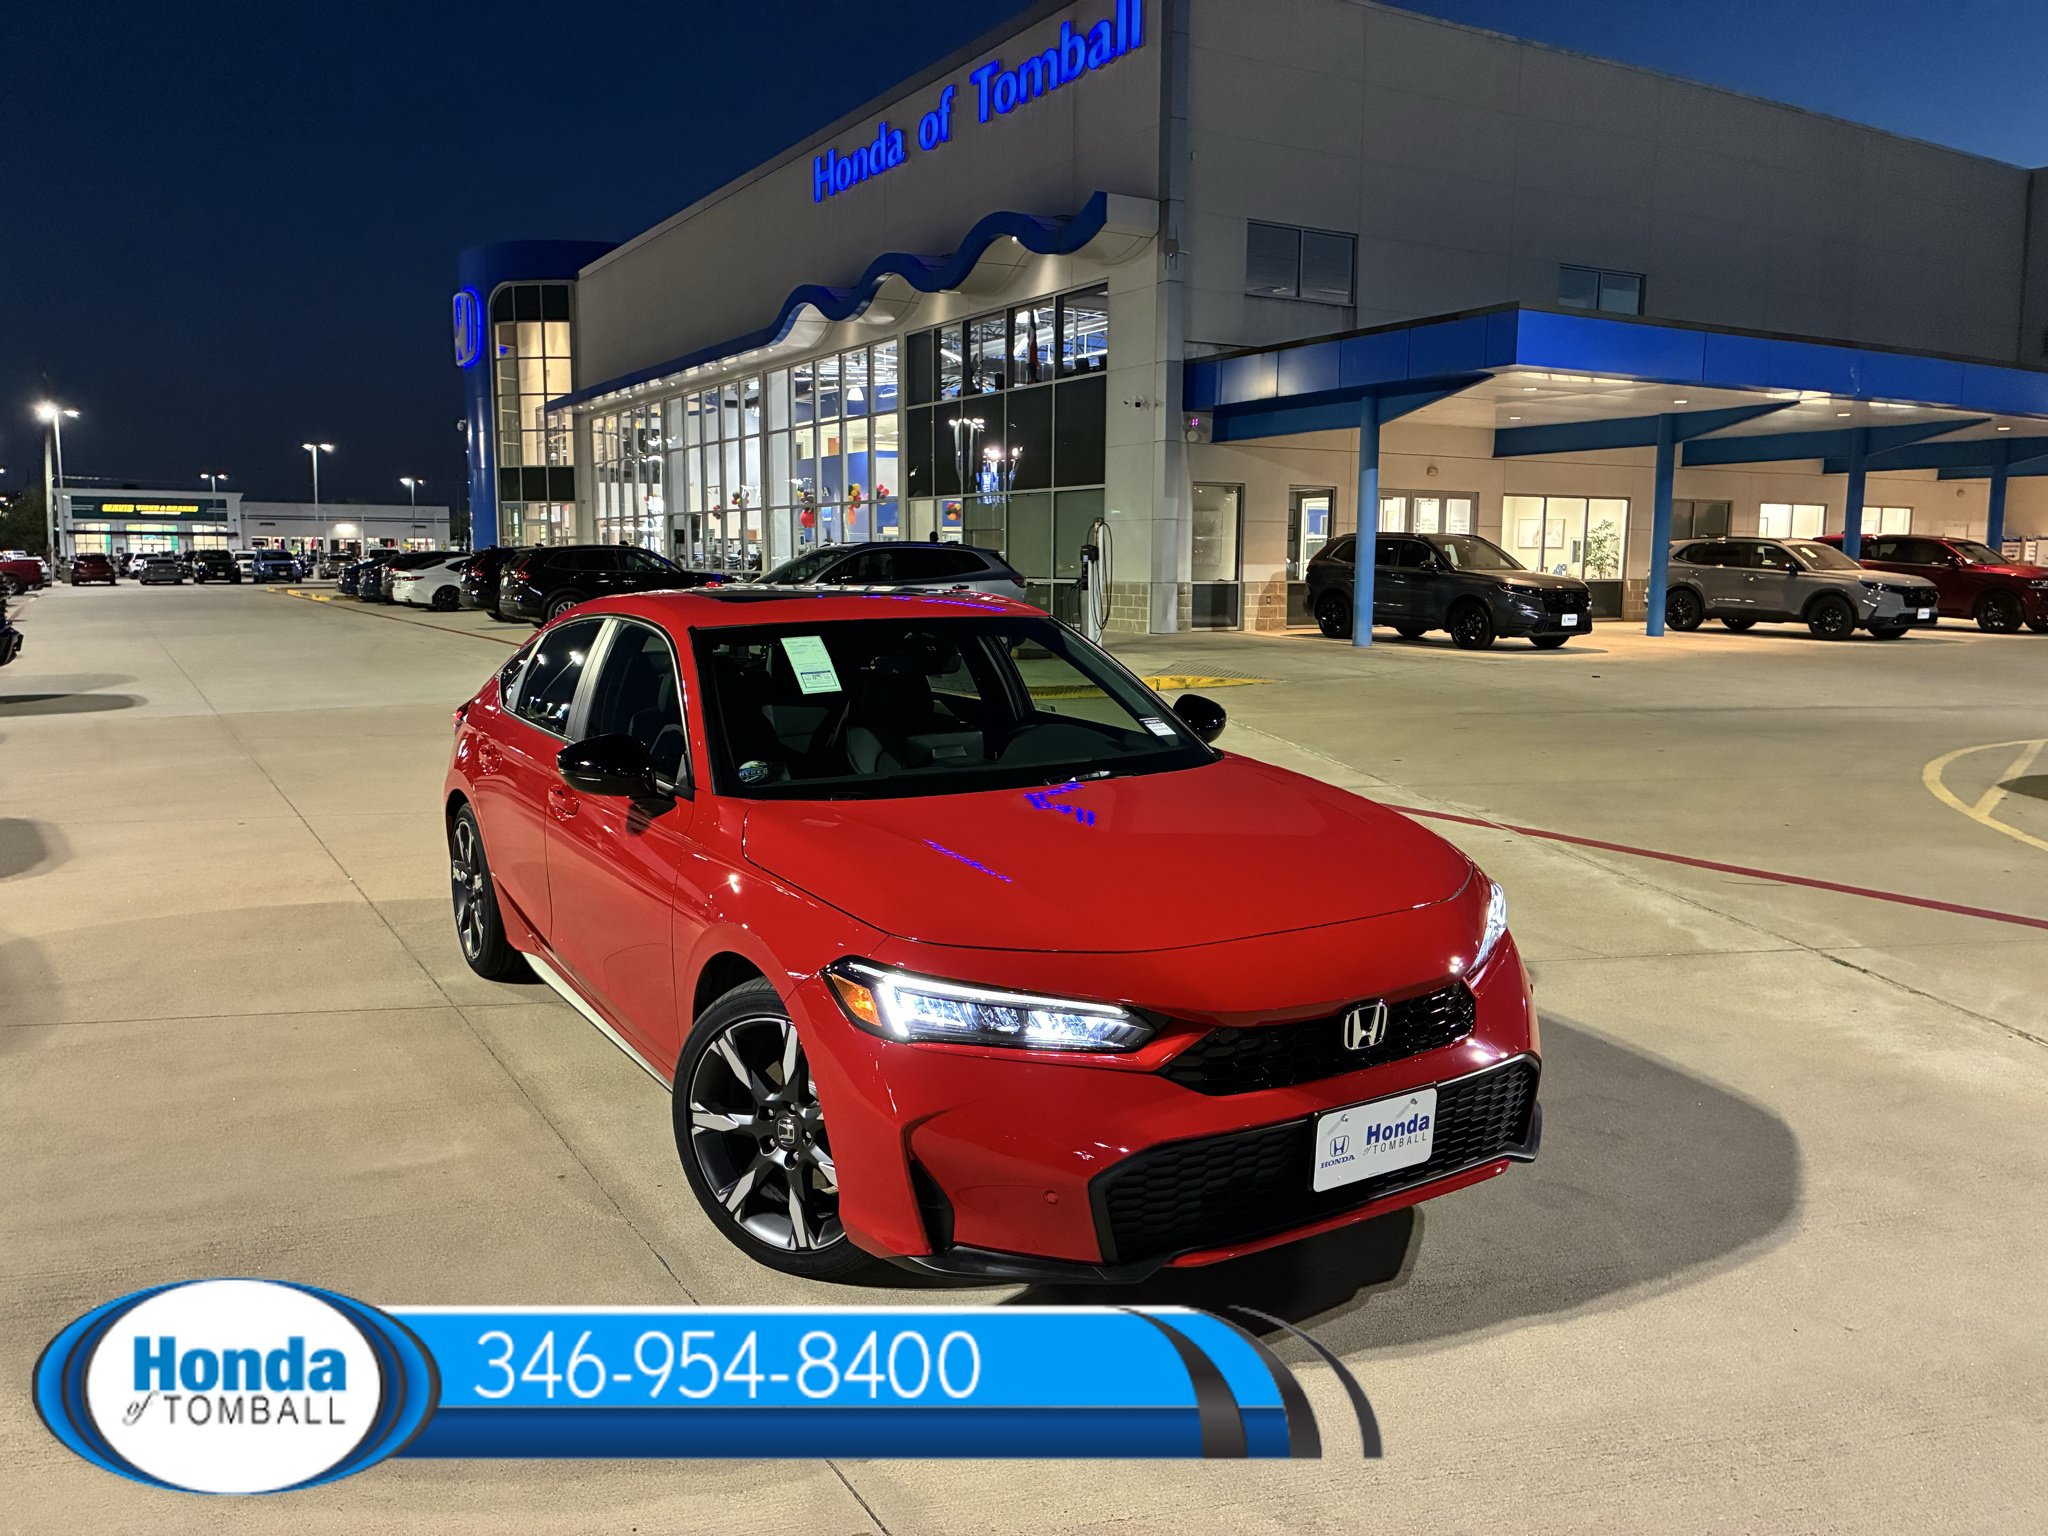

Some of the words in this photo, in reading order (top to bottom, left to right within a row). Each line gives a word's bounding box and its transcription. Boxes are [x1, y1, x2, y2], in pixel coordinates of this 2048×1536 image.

[813, 121, 906, 203] Honda
[918, 84, 955, 151] of
[969, 0, 1143, 124] Tomball
[1366, 1113, 1430, 1146] Honda
[1373, 1132, 1427, 1154] TOMBALL
[1320, 1154, 1355, 1169] HONDA
